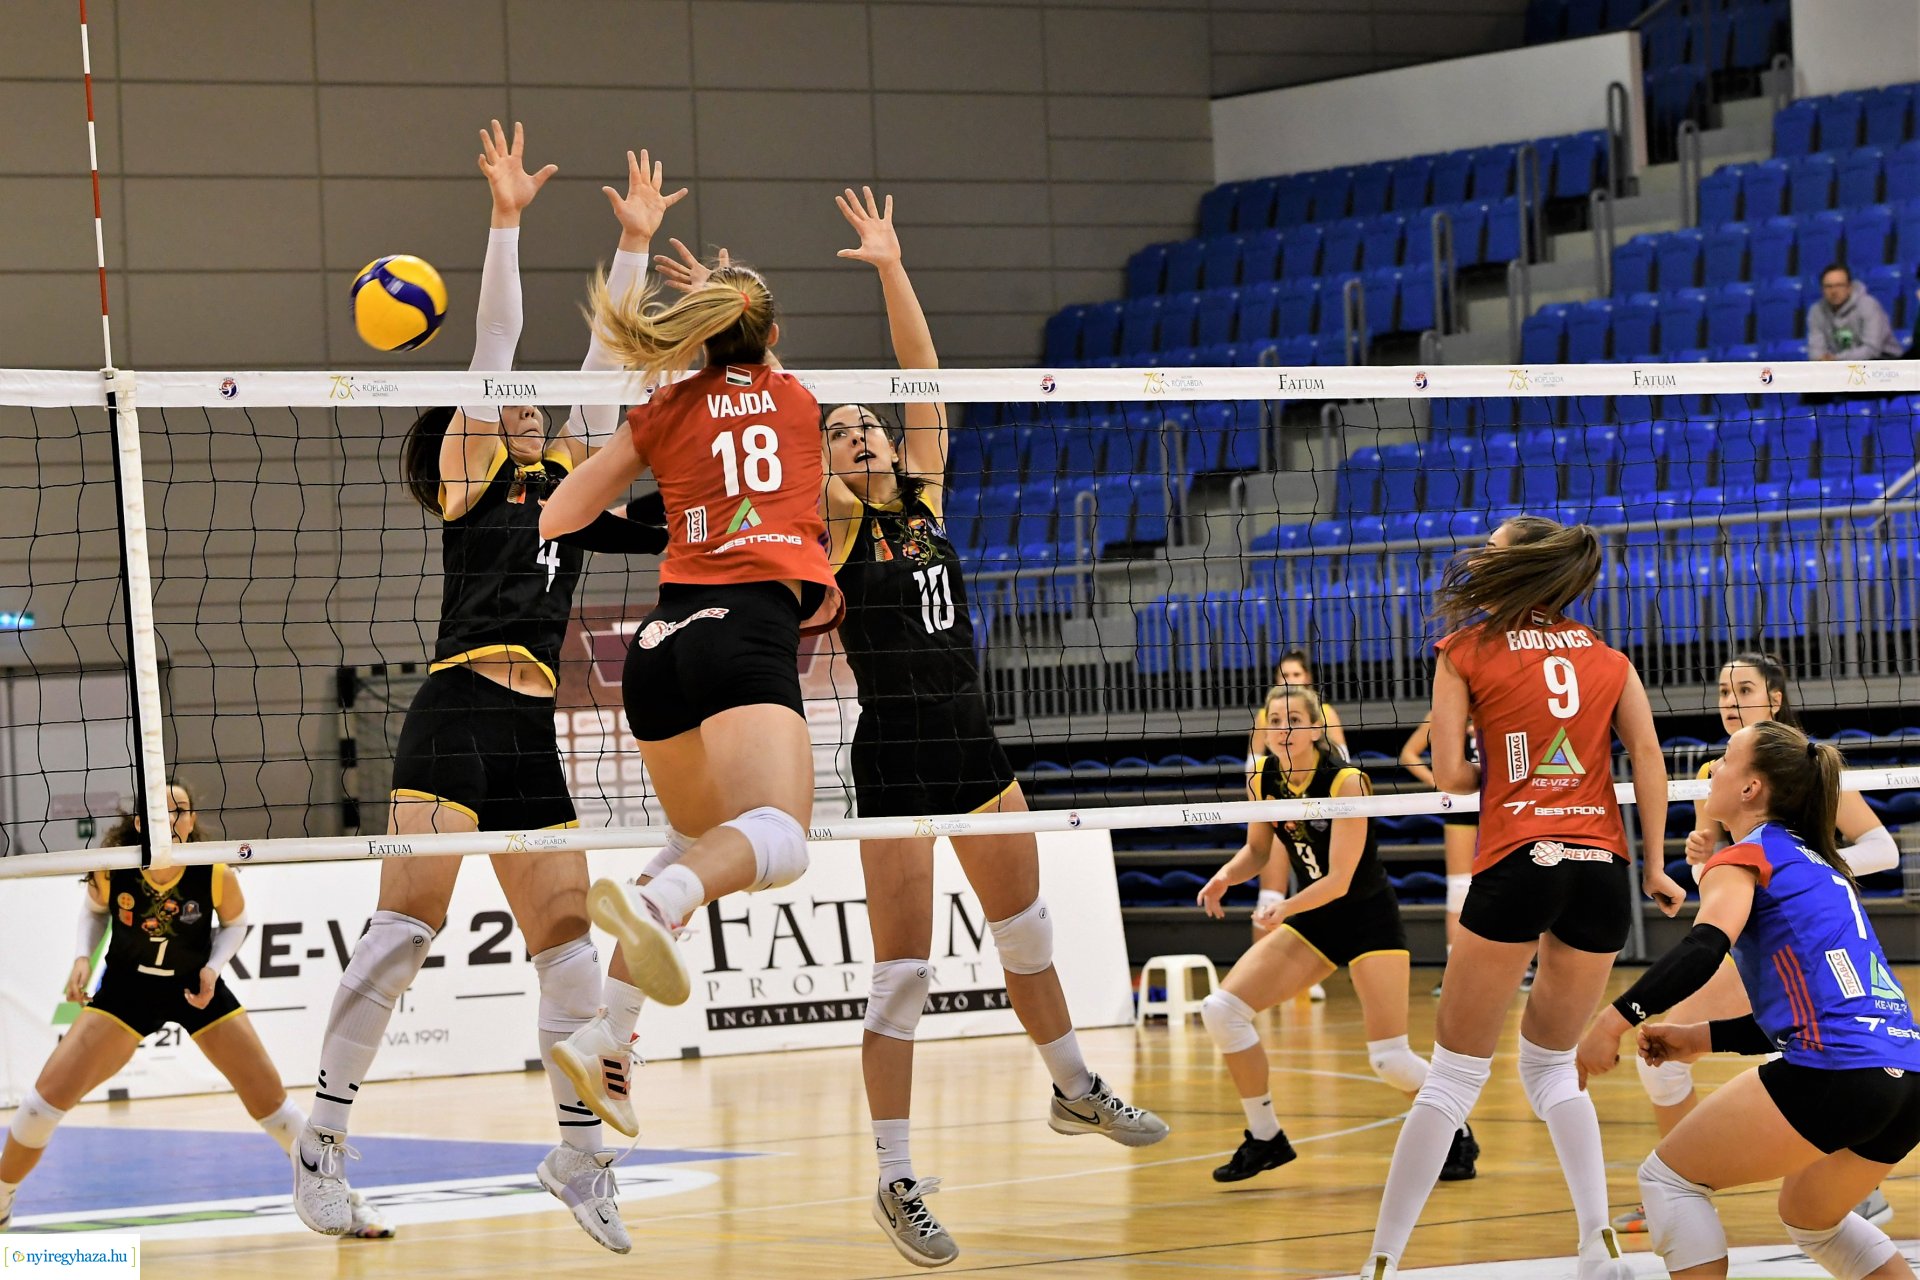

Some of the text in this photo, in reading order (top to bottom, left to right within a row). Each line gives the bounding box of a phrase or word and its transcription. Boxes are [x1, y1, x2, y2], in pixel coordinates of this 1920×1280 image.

[483, 378, 537, 396] FATUM
[890, 376, 941, 394] FATUM
[1278, 374, 1325, 390] FATUM
[1632, 370, 1676, 386] FATUM
[707, 390, 777, 418] VAJDA
[711, 425, 782, 497] 18
[536, 535, 560, 592] 4
[912, 564, 955, 634] 10
[1543, 655, 1580, 719] 9
[1512, 735, 1523, 779] STRABAG
[1531, 777, 1569, 788] KE-VIZ
[1182, 809, 1222, 823] FATUM
[1534, 806, 1606, 816] BESTRONG
[367, 840, 412, 855] FATUM
[1832, 874, 1867, 940] 7
[703, 891, 987, 975] FATM
[1833, 952, 1859, 995] STRABAG
[983, 990, 1009, 1008] KF
[415, 1028, 450, 1044] 1991
